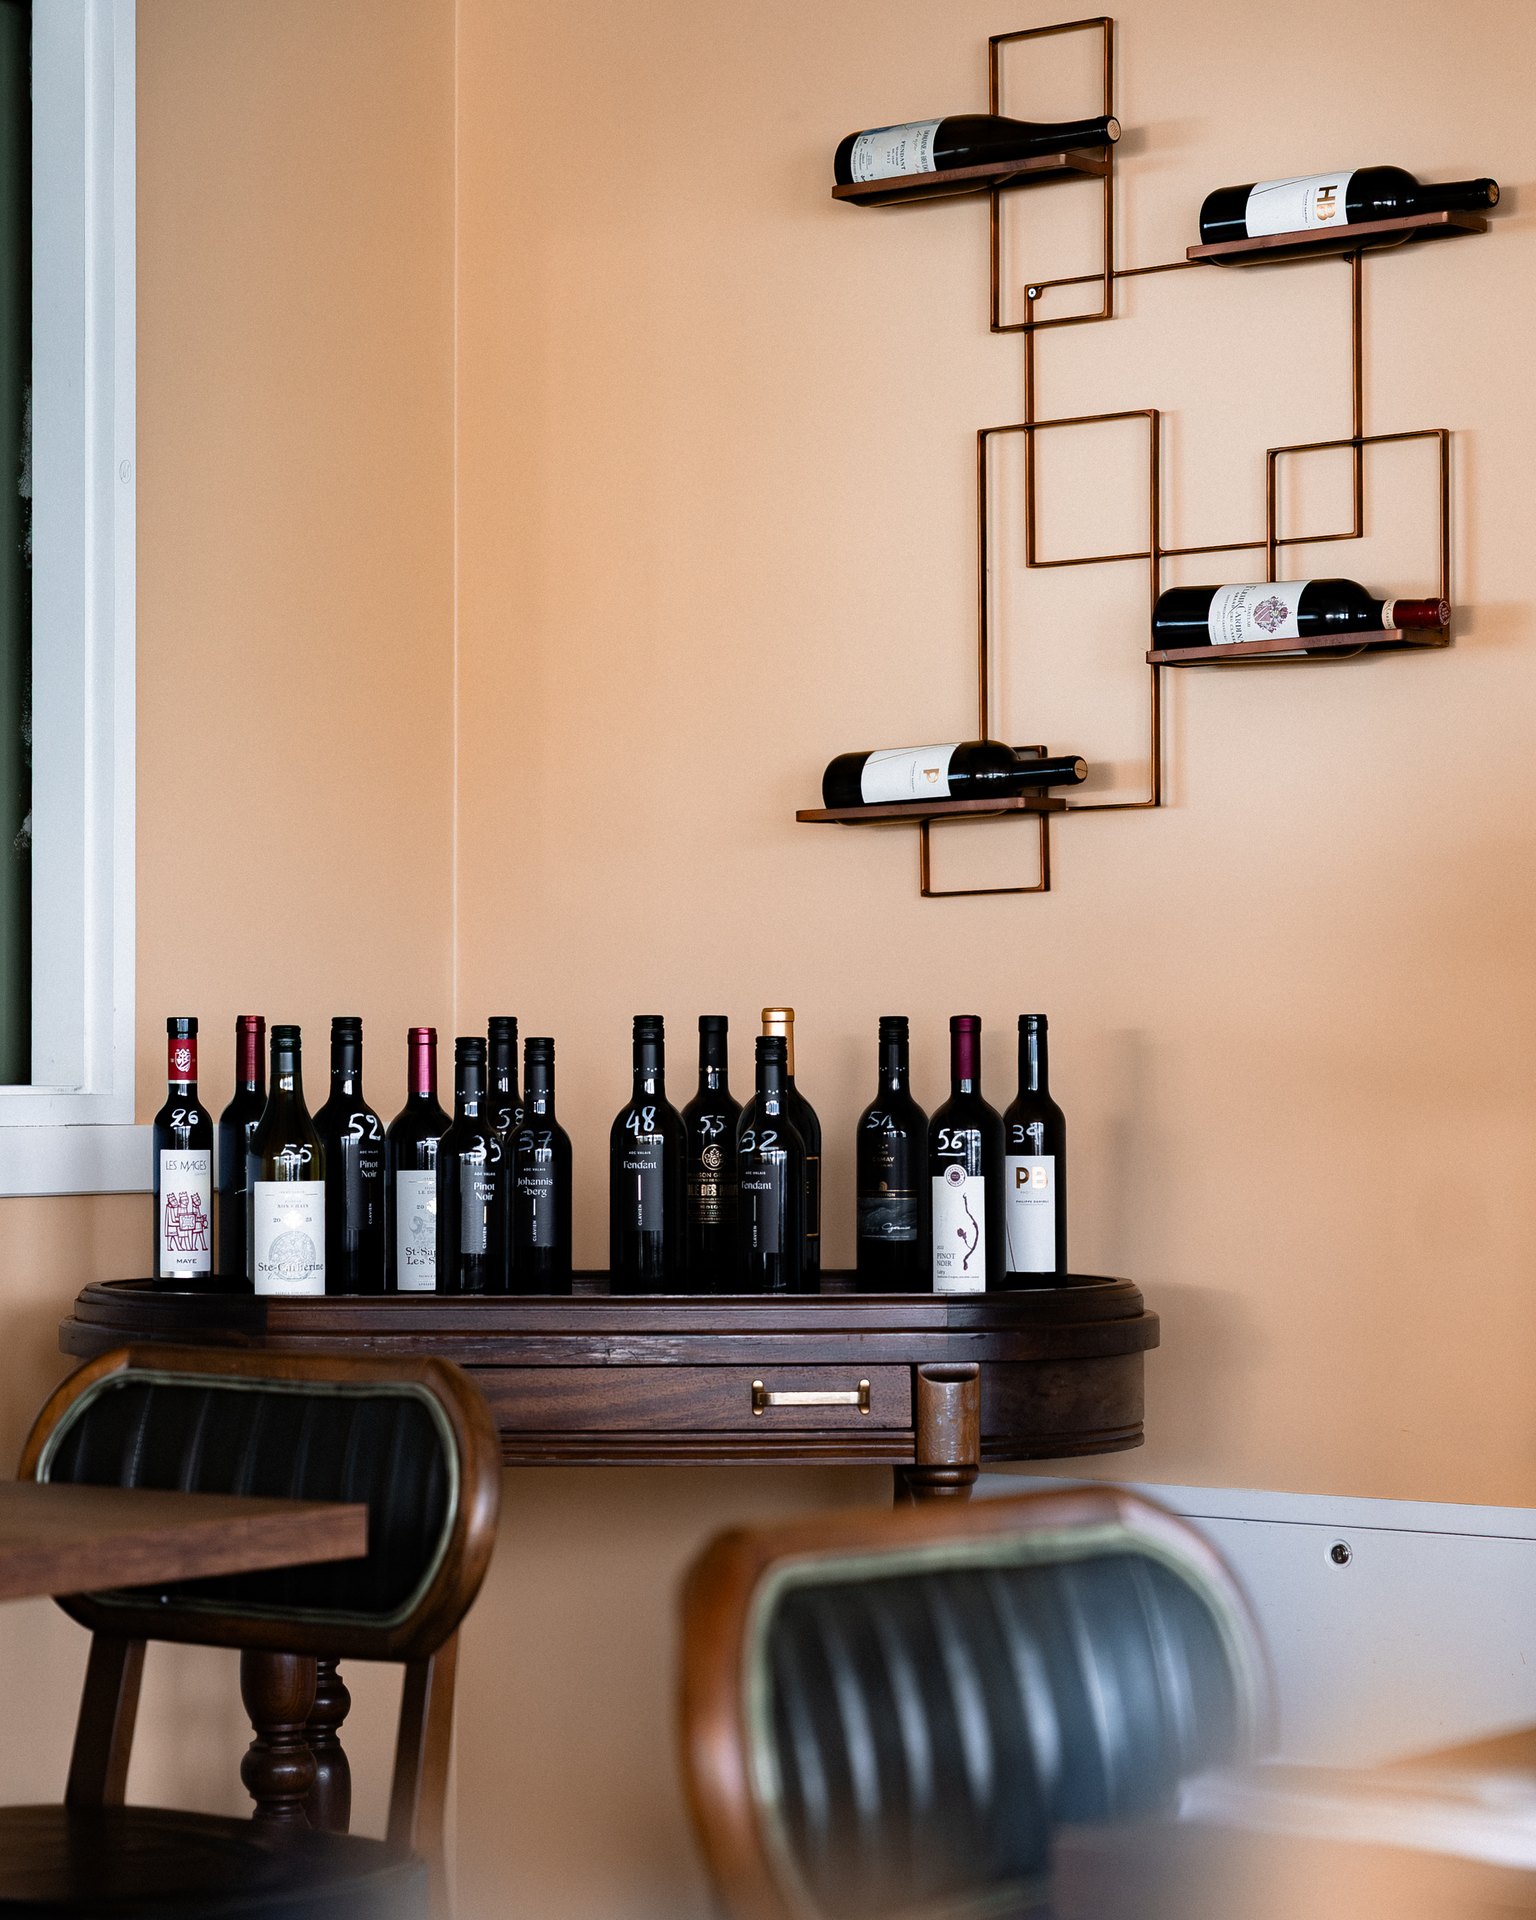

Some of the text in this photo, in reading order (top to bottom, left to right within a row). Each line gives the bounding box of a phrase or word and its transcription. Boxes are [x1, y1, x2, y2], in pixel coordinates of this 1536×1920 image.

[1234, 602, 1247, 643] CARDIN
[170, 1108, 199, 1128] 26
[496, 1107, 524, 1129] 58
[625, 1105, 657, 1136] 48
[348, 1112, 382, 1141] 52
[518, 1129, 553, 1151] 37
[739, 1129, 780, 1153] 32
[937, 1127, 963, 1150] 56
[165, 1159, 207, 1173] LES MAGES
[359, 1160, 379, 1169] Pinot
[623, 1159, 657, 1170] Fendant
[361, 1169, 377, 1178] Noir
[1015, 1166, 1049, 1189] PB
[473, 1181, 495, 1191] Pinot
[517, 1176, 553, 1188] Johannis
[741, 1179, 773, 1190] Fendant
[475, 1191, 494, 1201] Noir
[523, 1186, 548, 1198] -berg
[700, 1183, 717, 1197] DES
[406, 1256, 425, 1265] Les
[936, 1252, 956, 1260] PINOT
